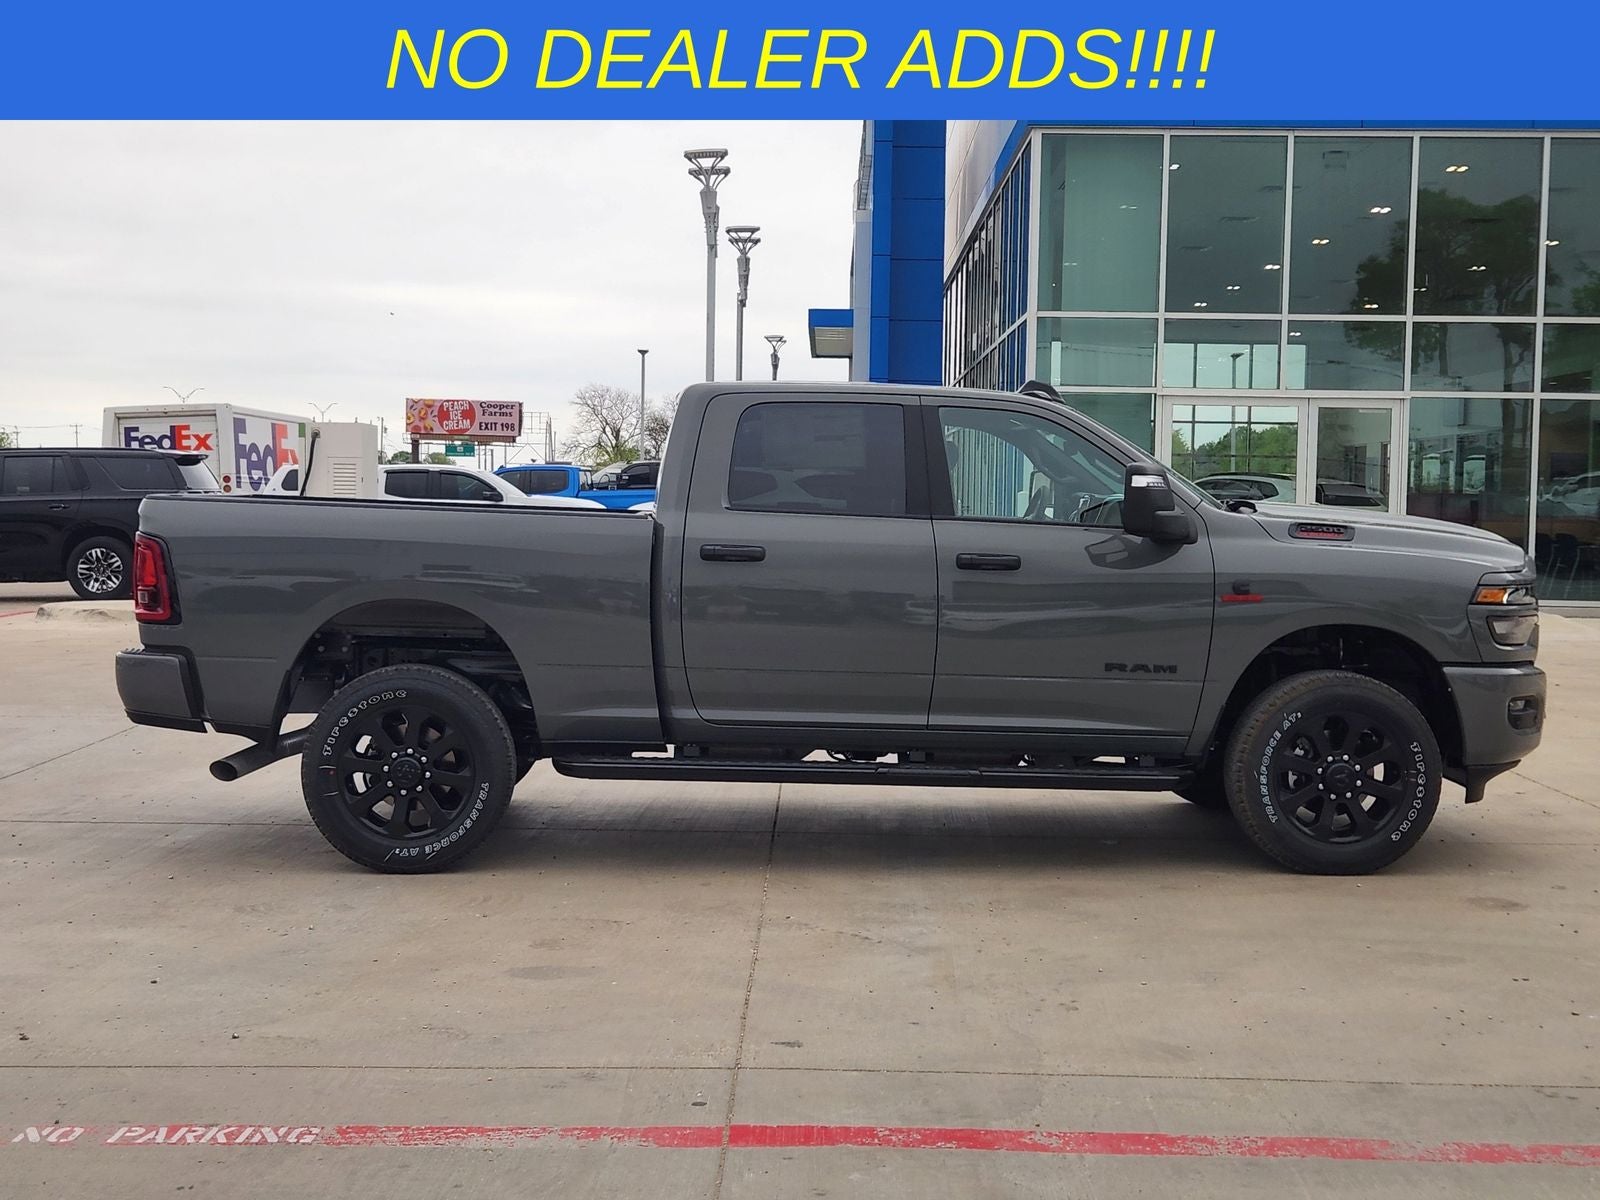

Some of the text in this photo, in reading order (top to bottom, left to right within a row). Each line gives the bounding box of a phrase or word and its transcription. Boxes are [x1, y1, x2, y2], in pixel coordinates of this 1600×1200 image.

[443, 401, 470, 411] PEACH
[479, 401, 516, 412] Cooper
[449, 411, 463, 421] ICE
[481, 409, 513, 418] Farms
[443, 420, 471, 430] CREAM
[478, 421, 516, 432] EXIT 198
[124, 424, 214, 451] FedEx
[1104, 662, 1178, 674] RAM
[1259, 730, 1283, 823] TRANSFORCE
[425, 782, 489, 854] TRANSFORCE
[11, 1126, 323, 1144] NO PARKING
